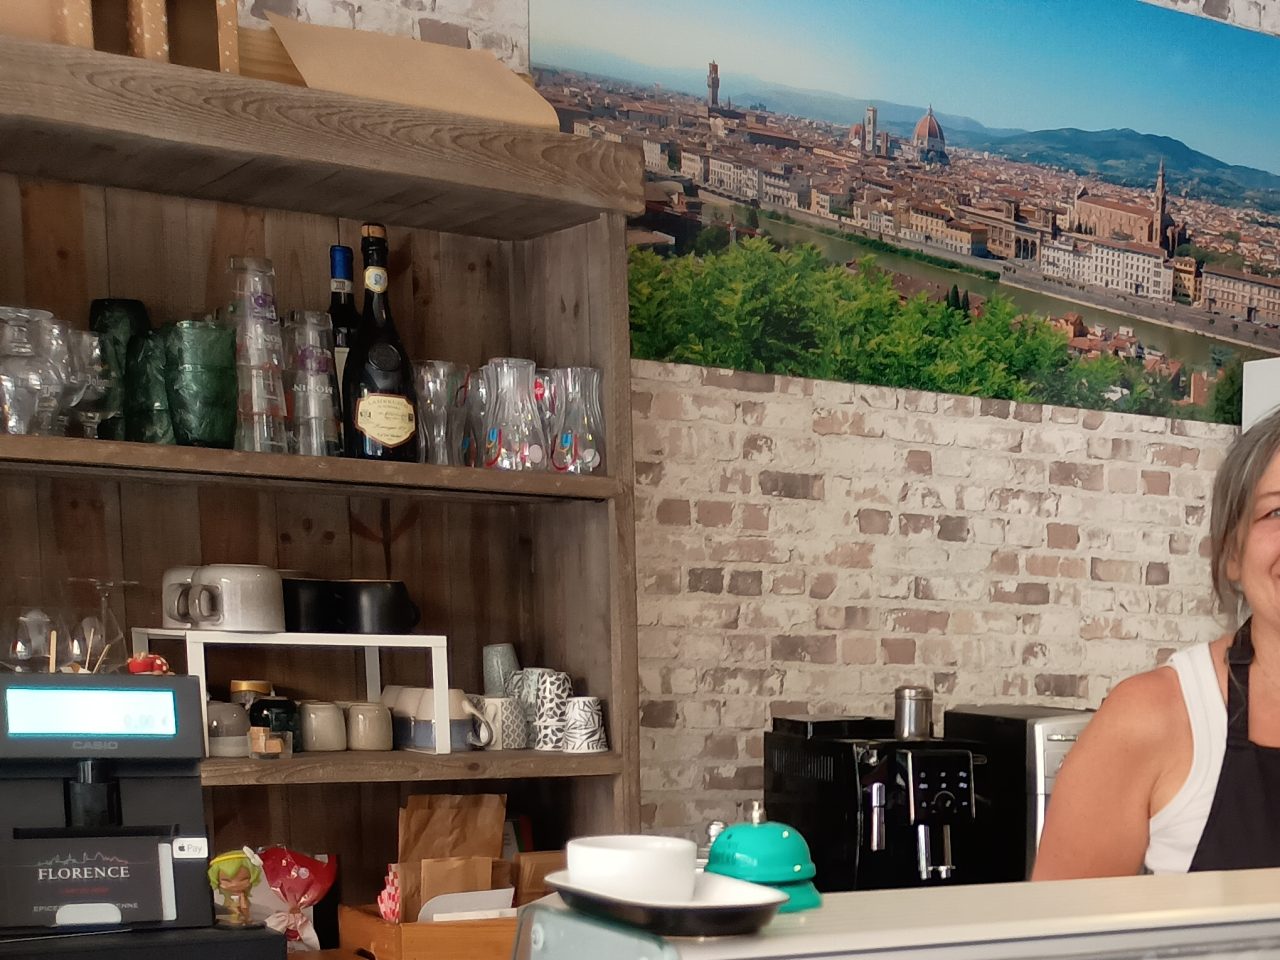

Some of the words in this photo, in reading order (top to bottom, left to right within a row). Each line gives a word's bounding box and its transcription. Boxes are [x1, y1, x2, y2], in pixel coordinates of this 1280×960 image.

[72, 741, 118, 750] CASIO
[187, 844, 203, 855] Pay
[38, 866, 131, 881] FLORENCE
